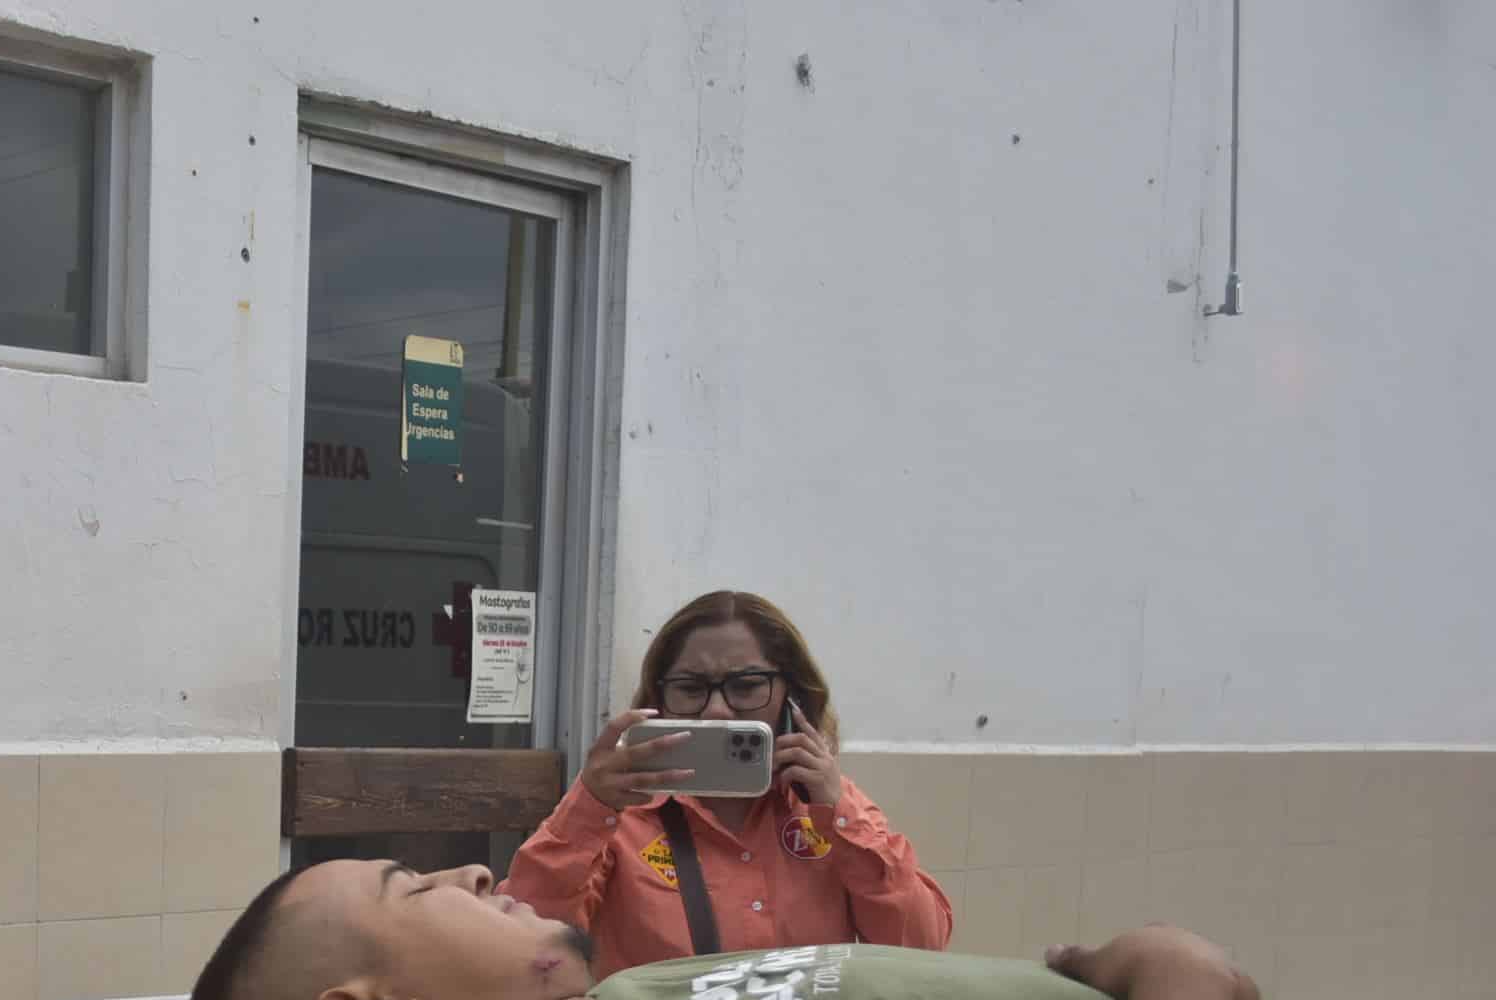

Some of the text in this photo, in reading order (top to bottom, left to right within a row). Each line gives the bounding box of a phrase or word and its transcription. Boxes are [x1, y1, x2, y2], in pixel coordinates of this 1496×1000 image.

[412, 383, 450, 401] Sala de
[412, 403, 449, 420] Espera
